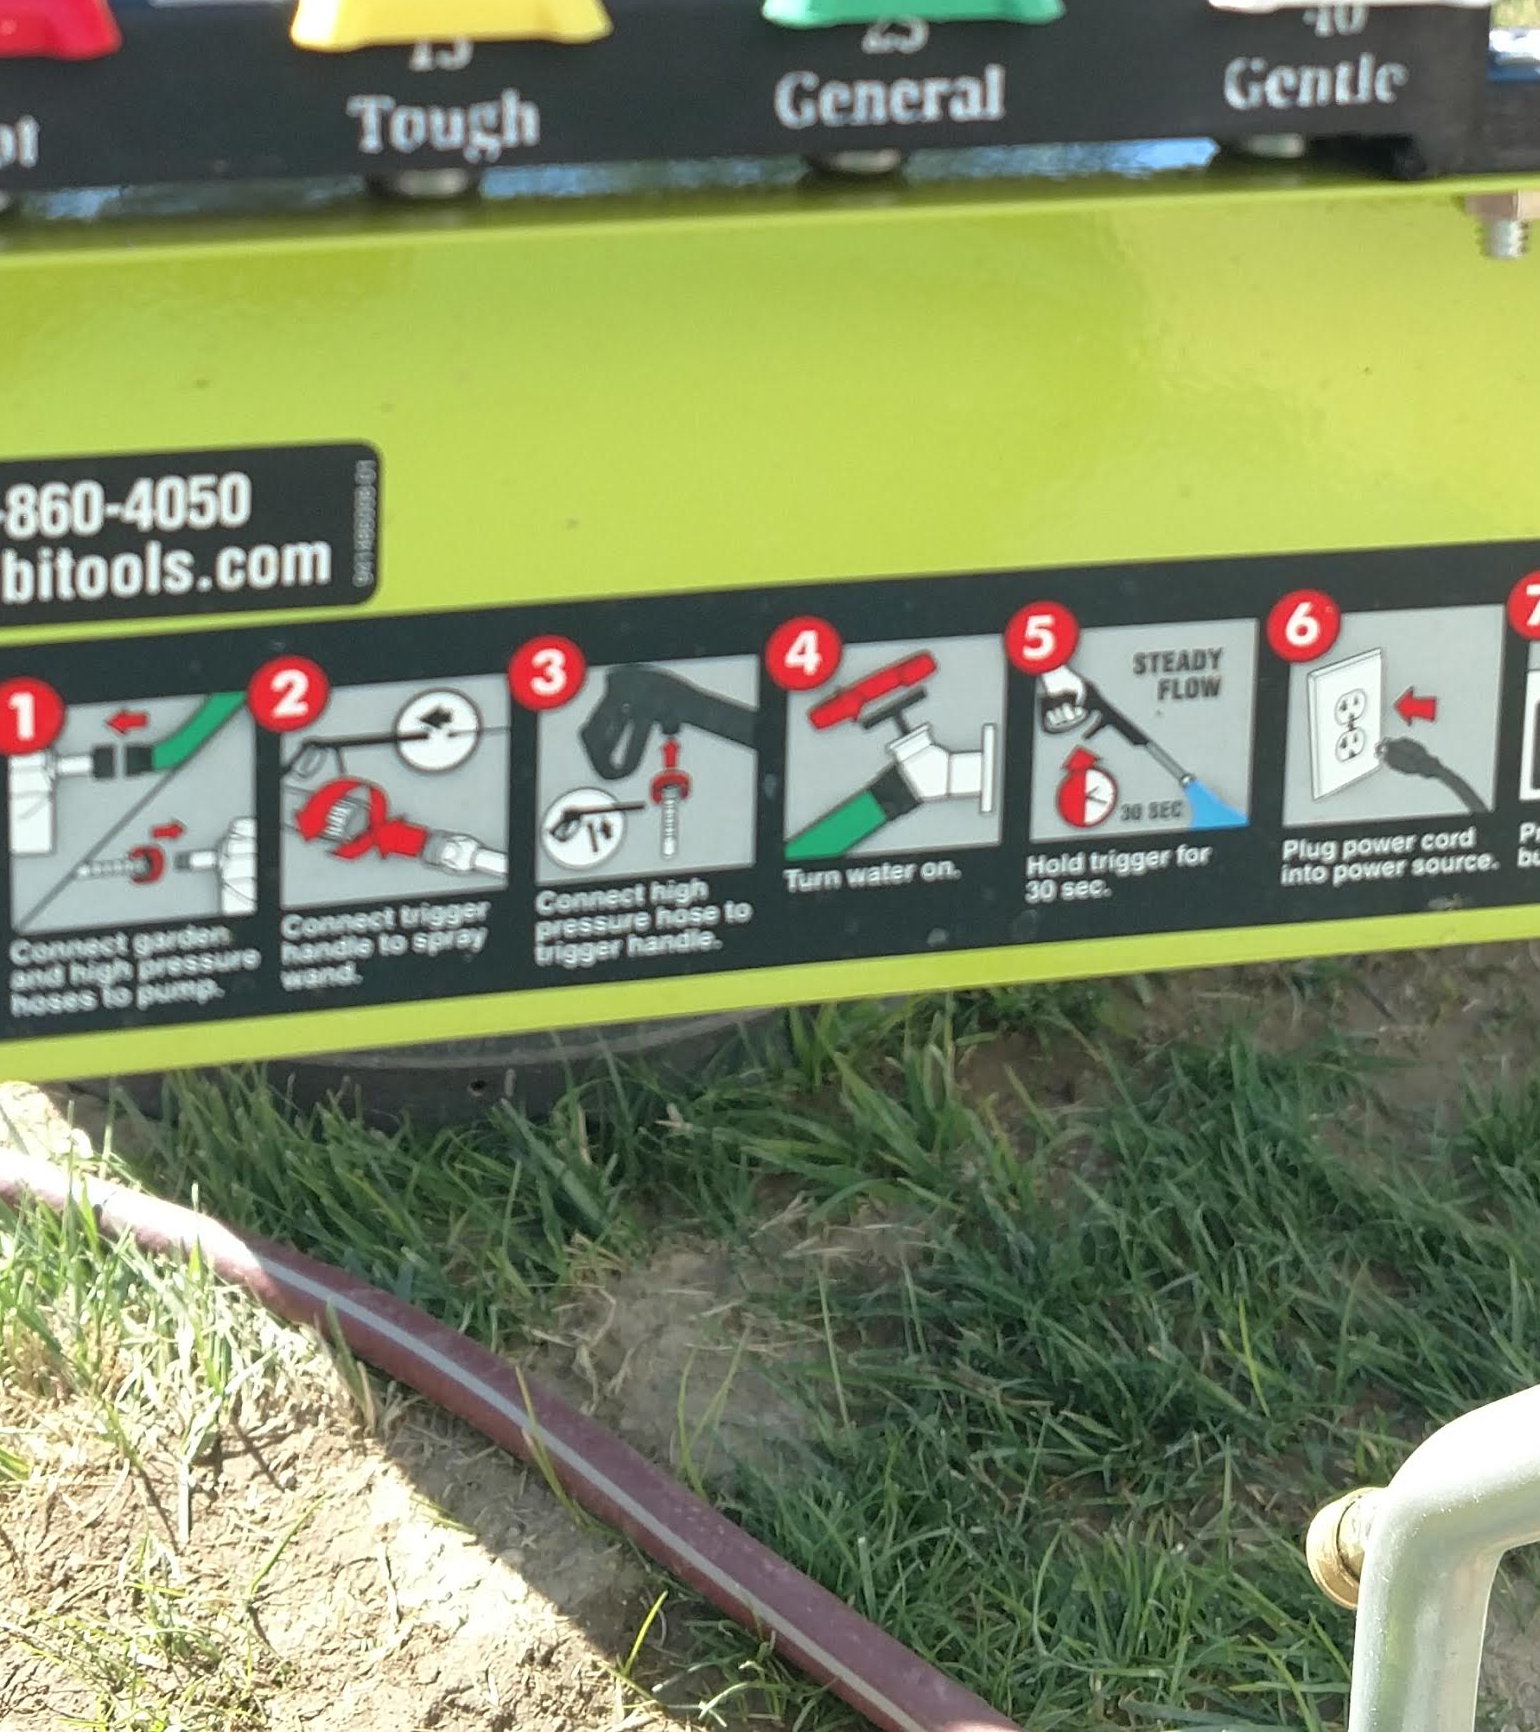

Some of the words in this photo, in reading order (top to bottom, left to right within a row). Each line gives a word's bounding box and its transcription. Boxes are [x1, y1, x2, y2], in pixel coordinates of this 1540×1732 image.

[774, 63, 1006, 129] General
[1224, 52, 1410, 110] Gentle
[346, 87, 541, 163] Tough
[1021, 616, 1056, 660] 5
[1285, 604, 1321, 646] 6
[784, 630, 822, 675] 4
[1133, 647, 1223, 675] STEADY
[530, 653, 568, 695] 3
[1157, 676, 1221, 700] FLOW
[270, 672, 309, 719] 2
[6, 695, 38, 741] 1
[1121, 802, 1142, 821] 30
[1026, 853, 1086, 878] Hold
[1089, 848, 1172, 876] trigger
[1176, 844, 1213, 866] for
[1283, 839, 1335, 865] Plug
[1342, 833, 1416, 860] power
[1421, 826, 1476, 850] cord
[783, 868, 841, 893] Turn
[846, 863, 916, 888] water
[920, 859, 962, 881] on.
[1281, 862, 1327, 886] into
[1332, 860, 1406, 889] power
[1411, 852, 1500, 879] source.
[535, 883, 645, 916] Connect
[650, 878, 709, 907] high
[1025, 879, 1057, 904] 30
[1061, 877, 1112, 899] sec.
[281, 908, 395, 938] Connect
[400, 900, 491, 929] trigger
[535, 910, 649, 942] pressure
[656, 904, 718, 931] hose
[723, 899, 753, 924] to
[10, 934, 128, 966] Connect
[132, 925, 231, 958] garden
[281, 936, 373, 965] handle
[379, 930, 408, 957] to
[413, 926, 489, 956] spray
[535, 938, 623, 968] trigger
[627, 930, 722, 958] handle.
[11, 964, 63, 992] and
[69, 959, 133, 988] high
[137, 948, 262, 982] pressure
[281, 963, 363, 991] wand.
[11, 987, 98, 1018] hoses
[102, 981, 133, 1009] to
[137, 978, 226, 1010] pump.
